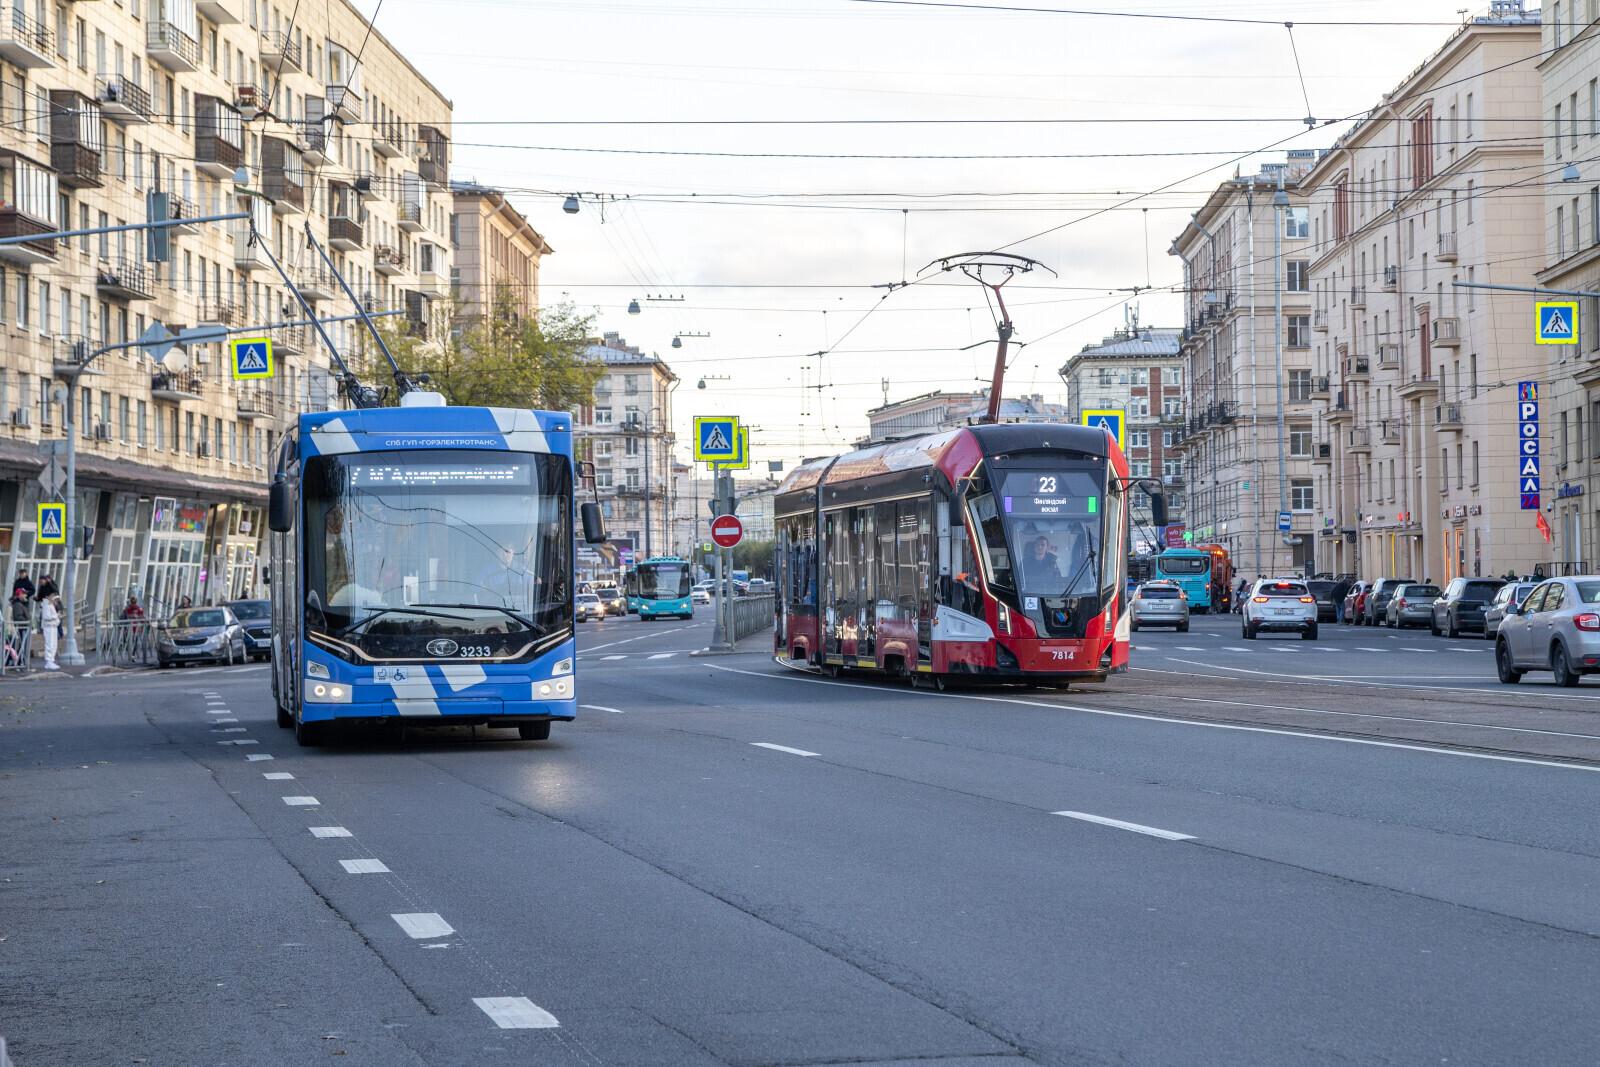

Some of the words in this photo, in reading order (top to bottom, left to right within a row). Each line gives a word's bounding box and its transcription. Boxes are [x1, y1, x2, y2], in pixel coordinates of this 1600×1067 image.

[402, 439, 417, 447] ГУП
[1039, 476, 1056, 493] 23
[1521, 495, 1540, 509] 24
[460, 646, 491, 658] 3233
[1052, 651, 1074, 660] 7814
